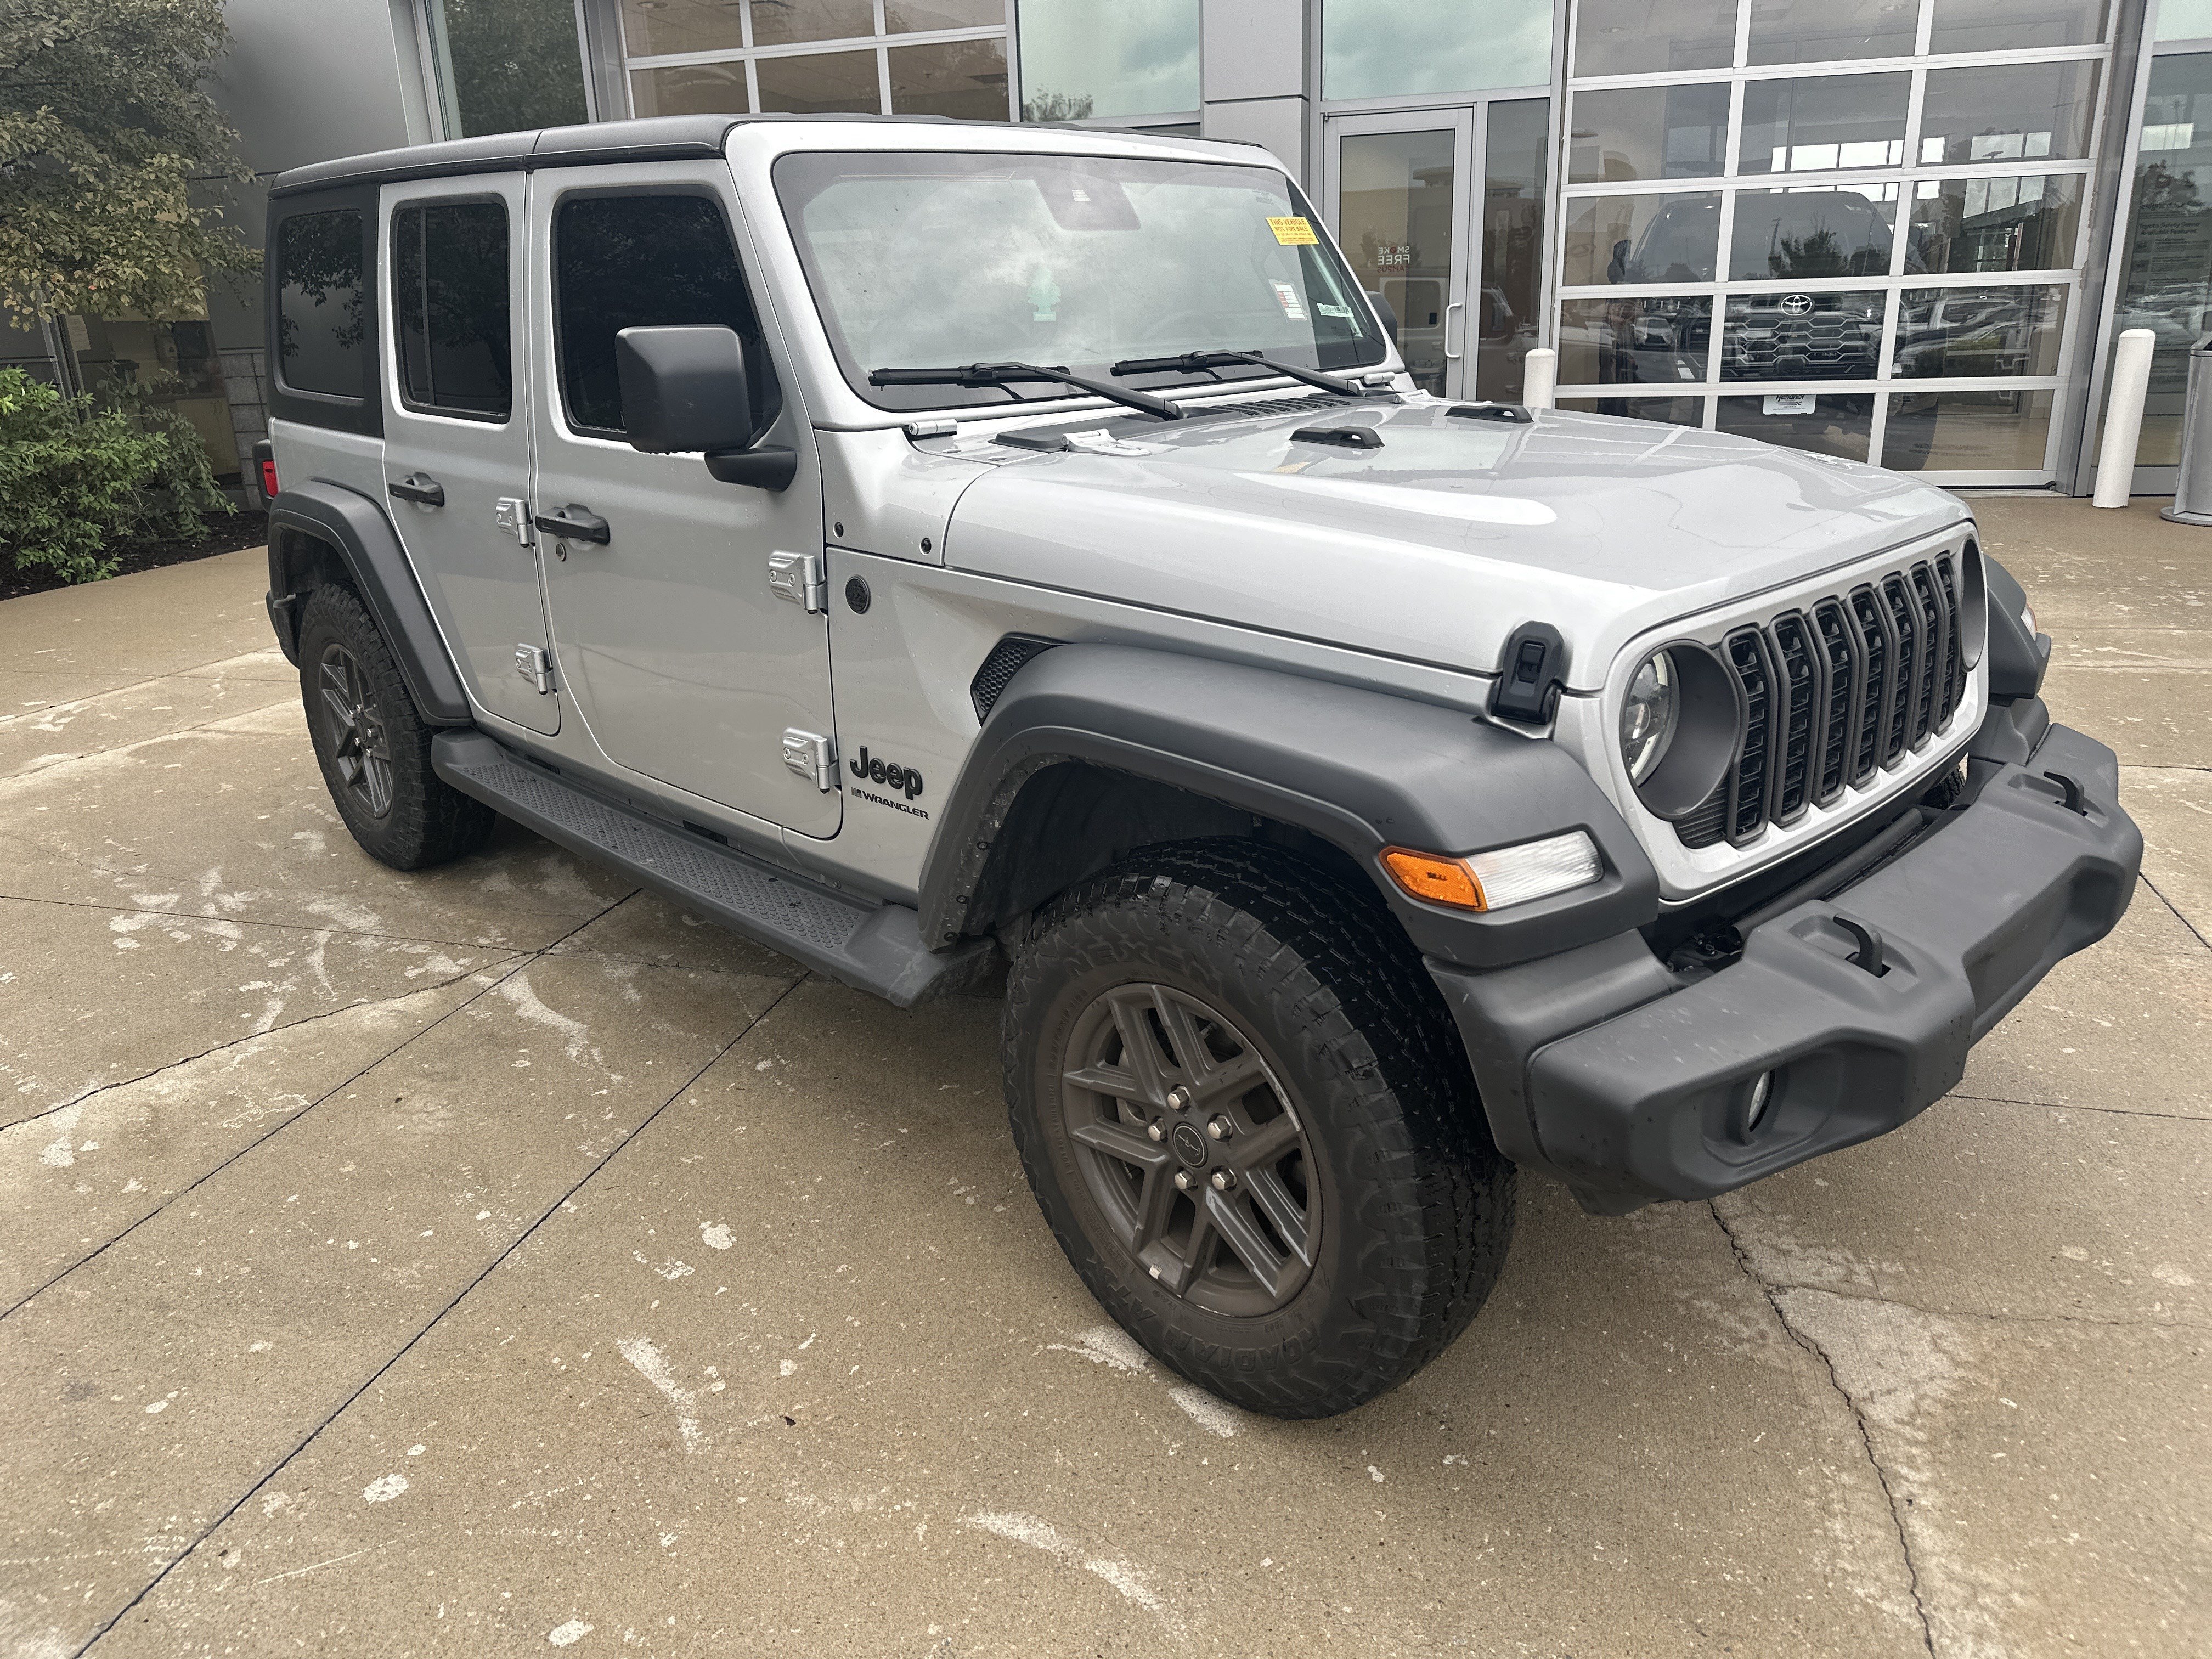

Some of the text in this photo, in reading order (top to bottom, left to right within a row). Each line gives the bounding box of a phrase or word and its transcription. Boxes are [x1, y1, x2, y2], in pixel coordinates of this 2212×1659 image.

[849, 745, 923, 800] Jeep
[862, 791, 929, 820] WRANGLER
[1161, 1323, 1320, 1373] ROADIAN
